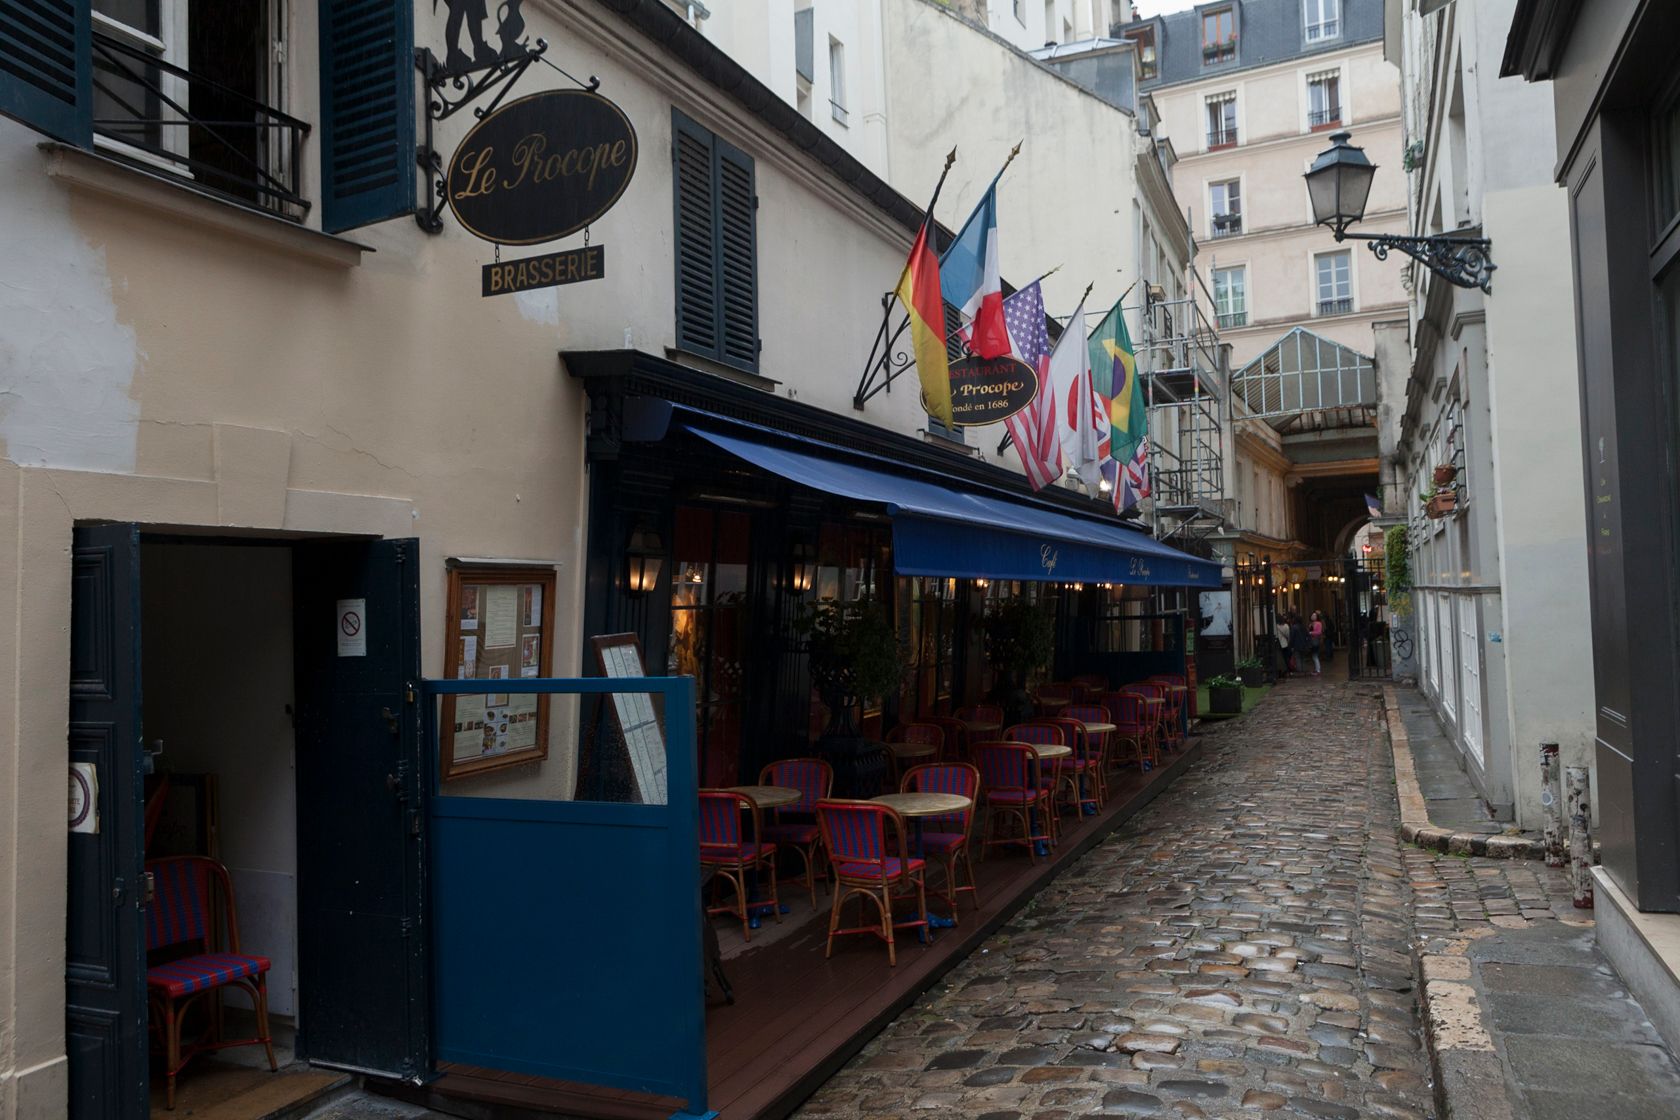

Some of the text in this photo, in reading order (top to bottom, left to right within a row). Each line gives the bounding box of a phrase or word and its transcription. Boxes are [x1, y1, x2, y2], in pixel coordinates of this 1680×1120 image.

[455, 133, 627, 200] Le Procope
[490, 250, 598, 292] BRASSERIE
[949, 363, 1017, 379] ESTAURANT
[960, 381, 1024, 397] Procope
[952, 399, 1009, 413] ondé en 1686
